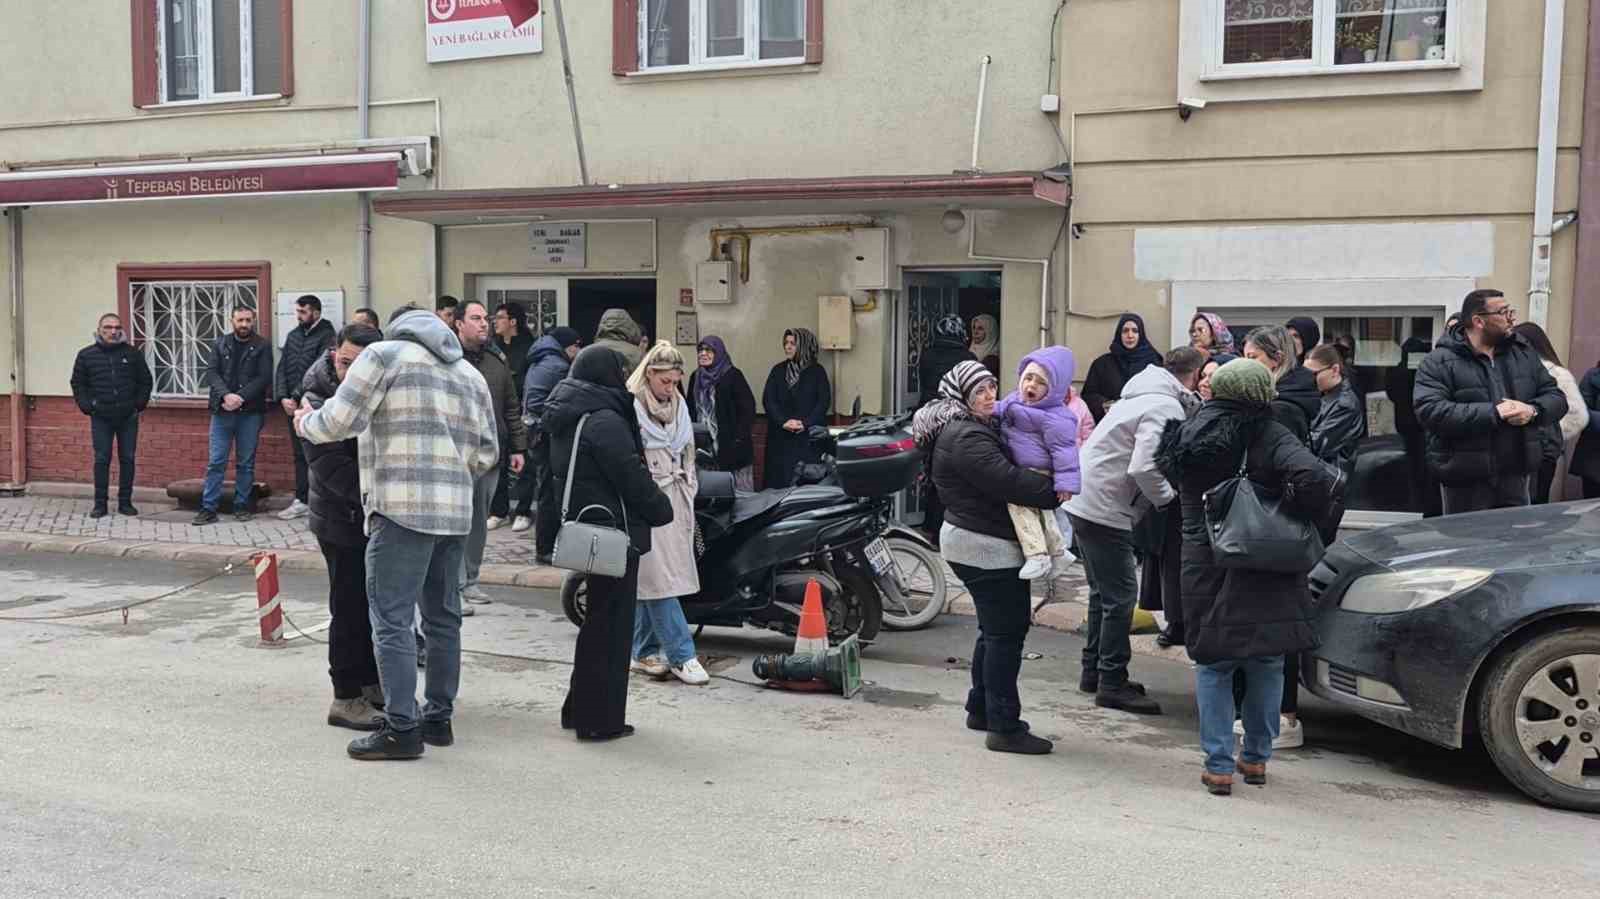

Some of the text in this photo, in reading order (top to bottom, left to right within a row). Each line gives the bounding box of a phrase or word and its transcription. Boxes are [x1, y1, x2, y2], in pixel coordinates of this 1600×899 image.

[432, 32, 456, 46] YENİ
[459, 30, 501, 43] BAĞLAR
[126, 174, 264, 196] TEPEBAŞI BELEDİYESİ
